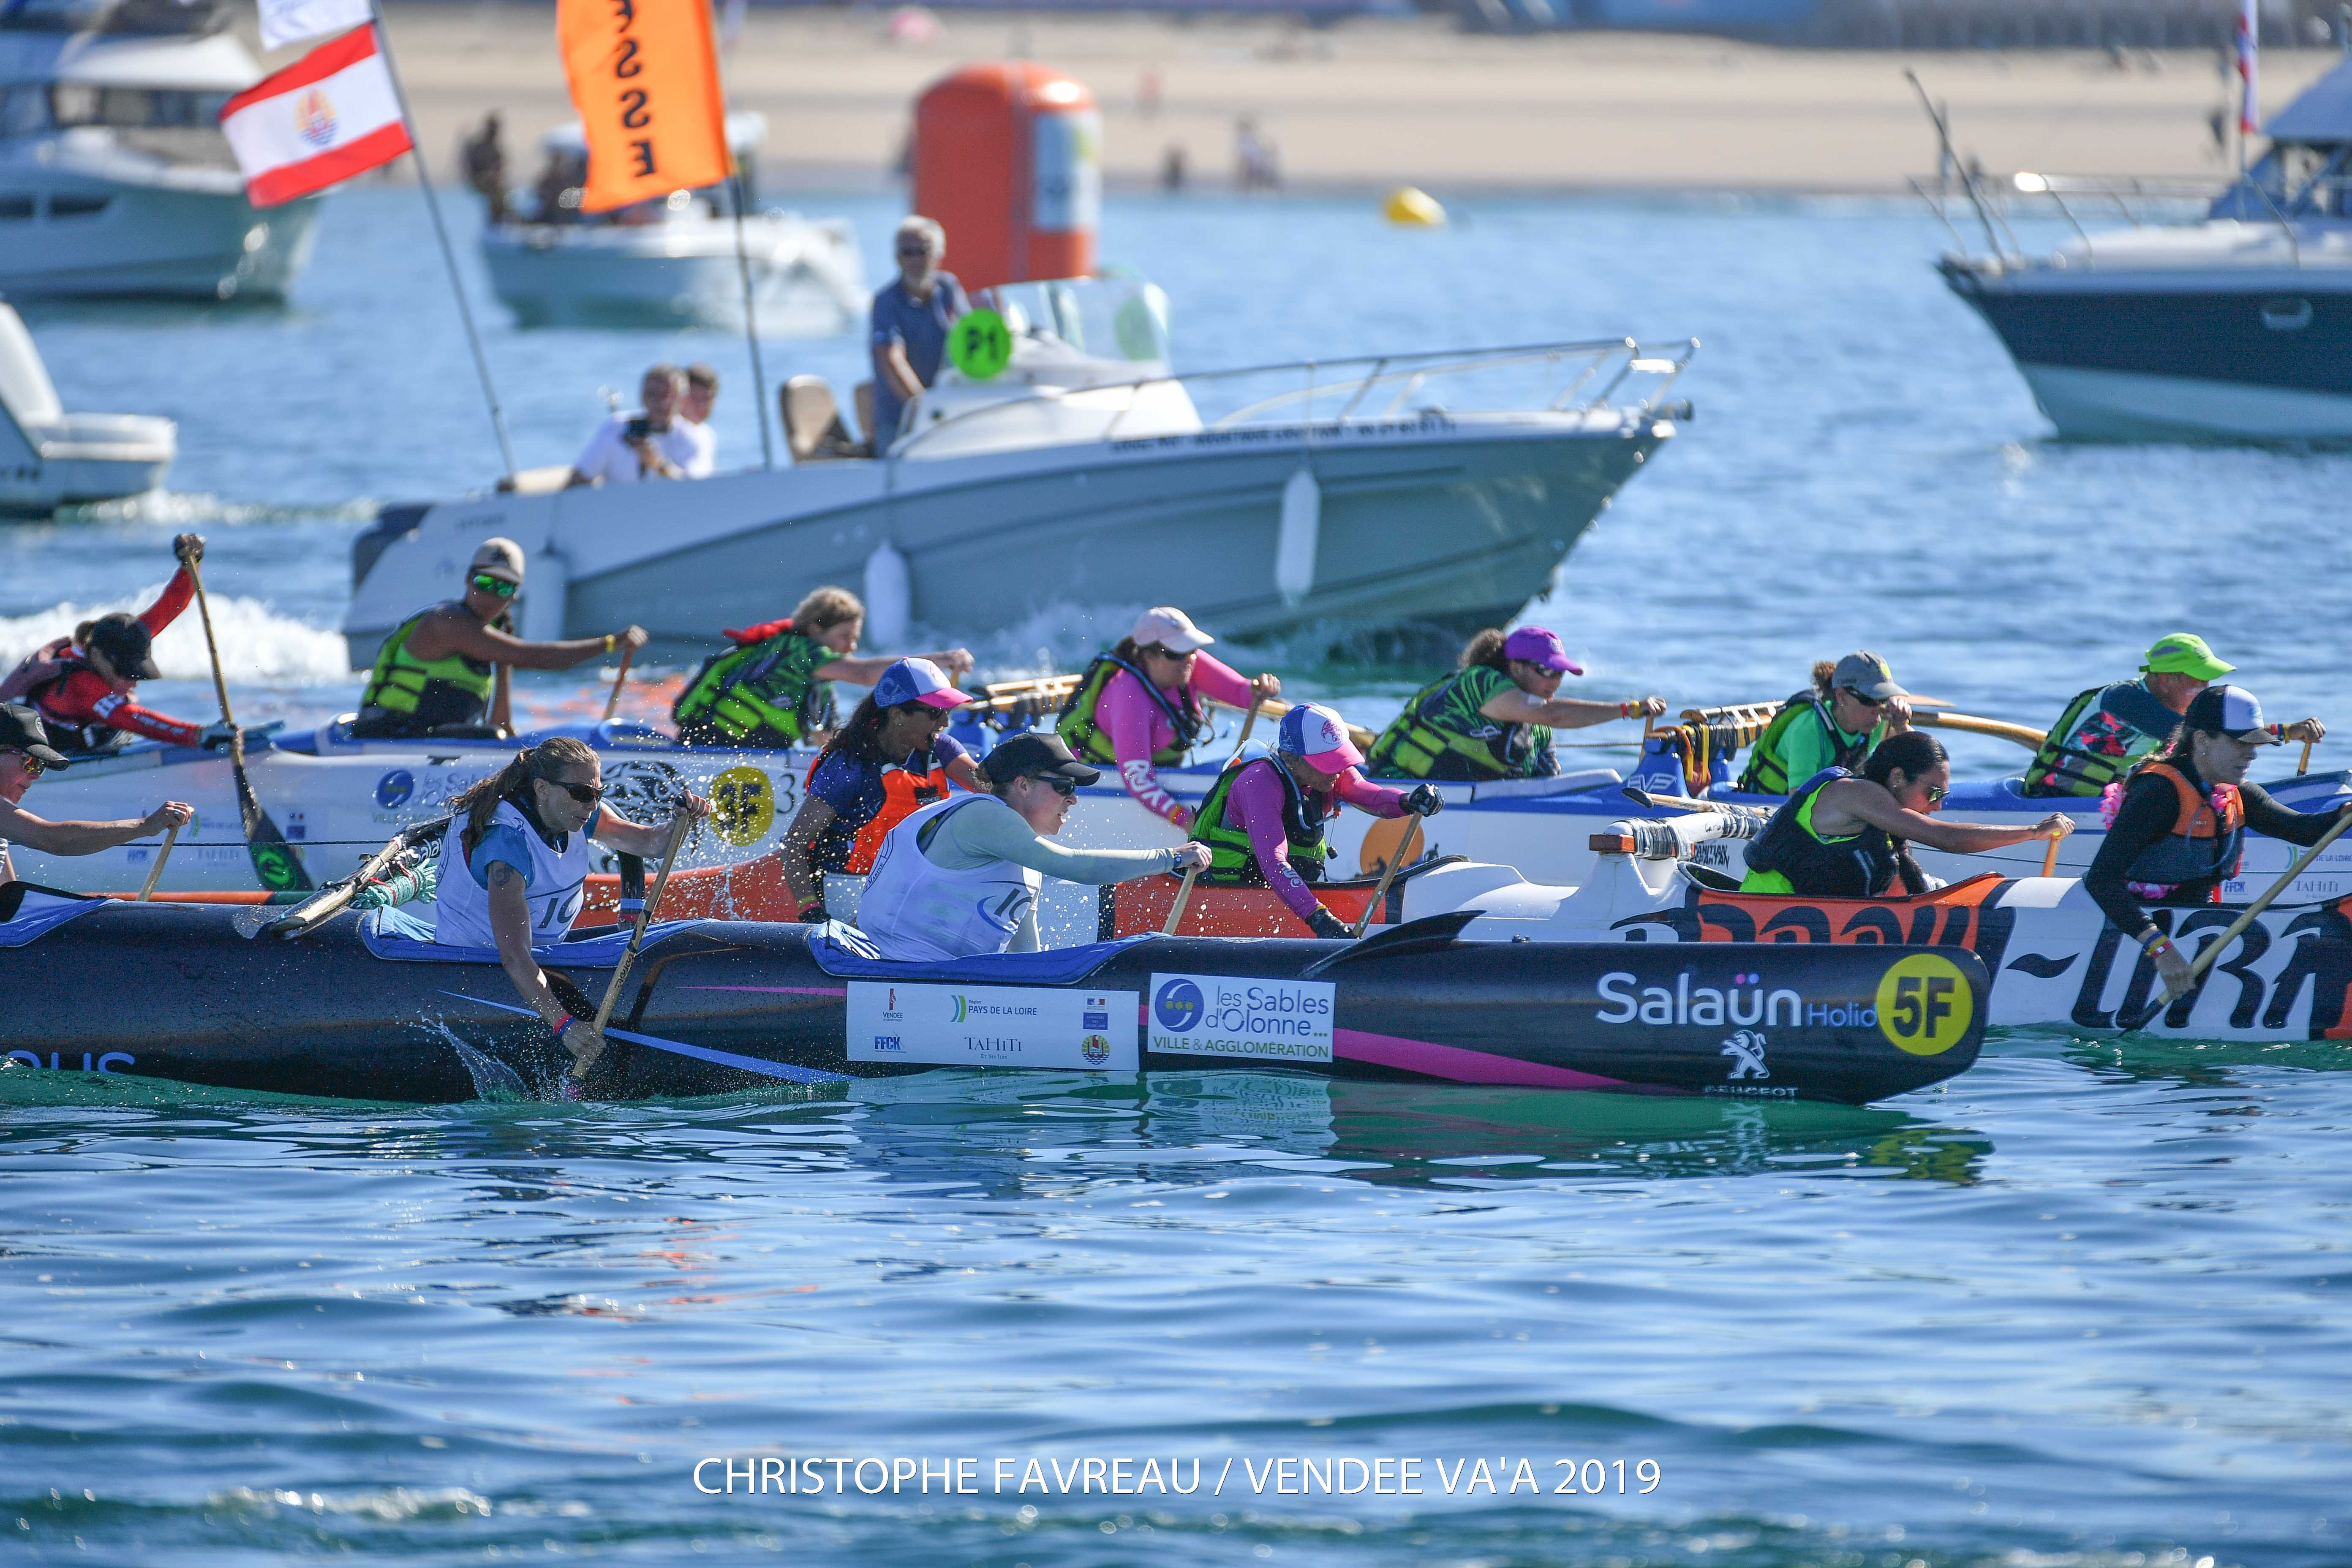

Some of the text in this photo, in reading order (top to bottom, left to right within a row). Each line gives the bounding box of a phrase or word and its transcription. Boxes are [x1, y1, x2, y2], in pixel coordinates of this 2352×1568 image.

[719, 784, 761, 833] 3F
[968, 1005, 1037, 1015] PAYS DE LA LOIRE
[1217, 985, 1329, 1015] les Sables
[1597, 972, 1802, 1026] Salaün
[1893, 976, 1955, 1038] 5F
[874, 1036, 901, 1051] FFCK
[1154, 1036, 1328, 1058] VILLE & AGGLOMÉRATION
